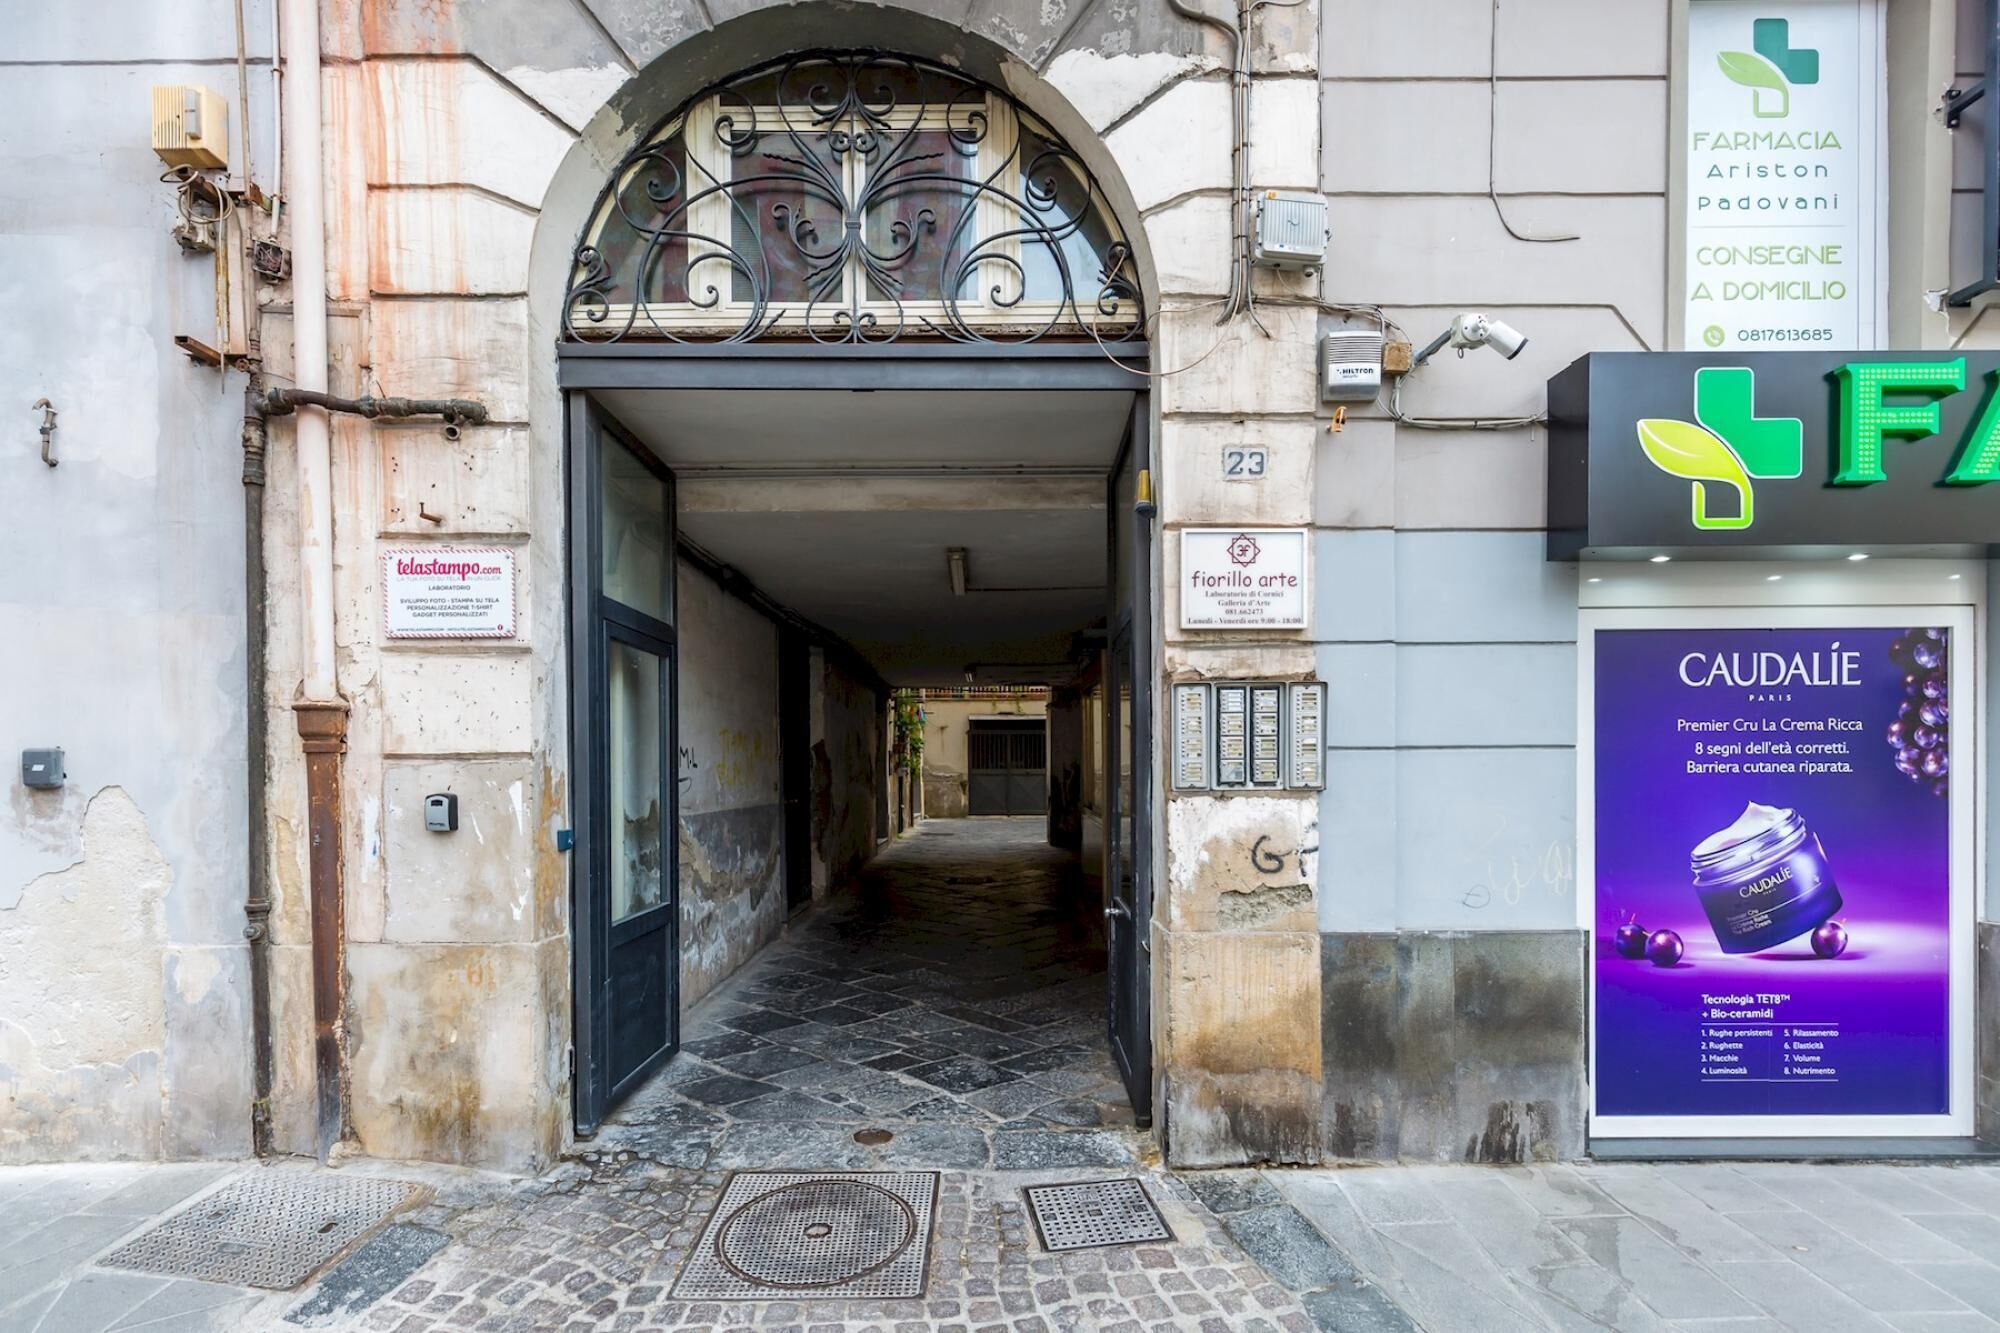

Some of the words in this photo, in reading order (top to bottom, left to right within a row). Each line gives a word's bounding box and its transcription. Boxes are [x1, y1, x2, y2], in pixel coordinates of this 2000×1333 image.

[1693, 131, 1842, 151] FARMACIA
[1706, 163, 1829, 179] Ariston
[1698, 193, 1839, 210] Padovani
[1696, 245, 1843, 266] CONSEGNE
[1690, 282, 1714, 301] A
[1723, 280, 1847, 301] DOMICILIO
[1737, 328, 1833, 342] 0817613685
[1228, 451, 1264, 475] 23
[397, 556, 502, 581] telastampo.com
[1192, 570, 1252, 588] fiorillo
[1258, 572, 1298, 588] arte
[1205, 590, 1247, 598] Laboratorio
[1248, 590, 1256, 598] di
[1257, 590, 1284, 598] Cornici
[1749, 694, 1792, 702] PARIS
[1677, 719, 1729, 732] Premier
[1733, 718, 1758, 732] Cru
[1762, 718, 1776, 731] La
[1780, 718, 1824, 731] Crema
[1828, 718, 1863, 731] Ricca
[1695, 742, 1704, 755] 8
[1706, 742, 1742, 757] segni
[1795, 742, 1850, 754] corretti.
[1687, 760, 1740, 773] Barriera
[1743, 761, 1795, 773] cutanea
[1799, 760, 1853, 775] riparata.
[1701, 994, 1754, 1006] Tecnologia
[1710, 1008, 1774, 1018] Bio-ceramidi
[1701, 1029, 1707, 1037] 1.
[1709, 1029, 1733, 1038] Rughe
[1734, 1029, 1773, 1038] persistenti
[1783, 1029, 1791, 1037] 5.
[1792, 1029, 1839, 1037] Rilassamento
[1709, 1042, 1743, 1050] Rughette
[1792, 1041, 1824, 1049] Elasticità
[1701, 1054, 1707, 1062] 3.
[1709, 1054, 1739, 1062] Macchie
[1783, 1054, 1791, 1062] 7.
[1792, 1054, 1821, 1062] Volume
[1709, 1067, 1748, 1075] Luminosità
[1792, 1067, 1836, 1075] Nutrimento
